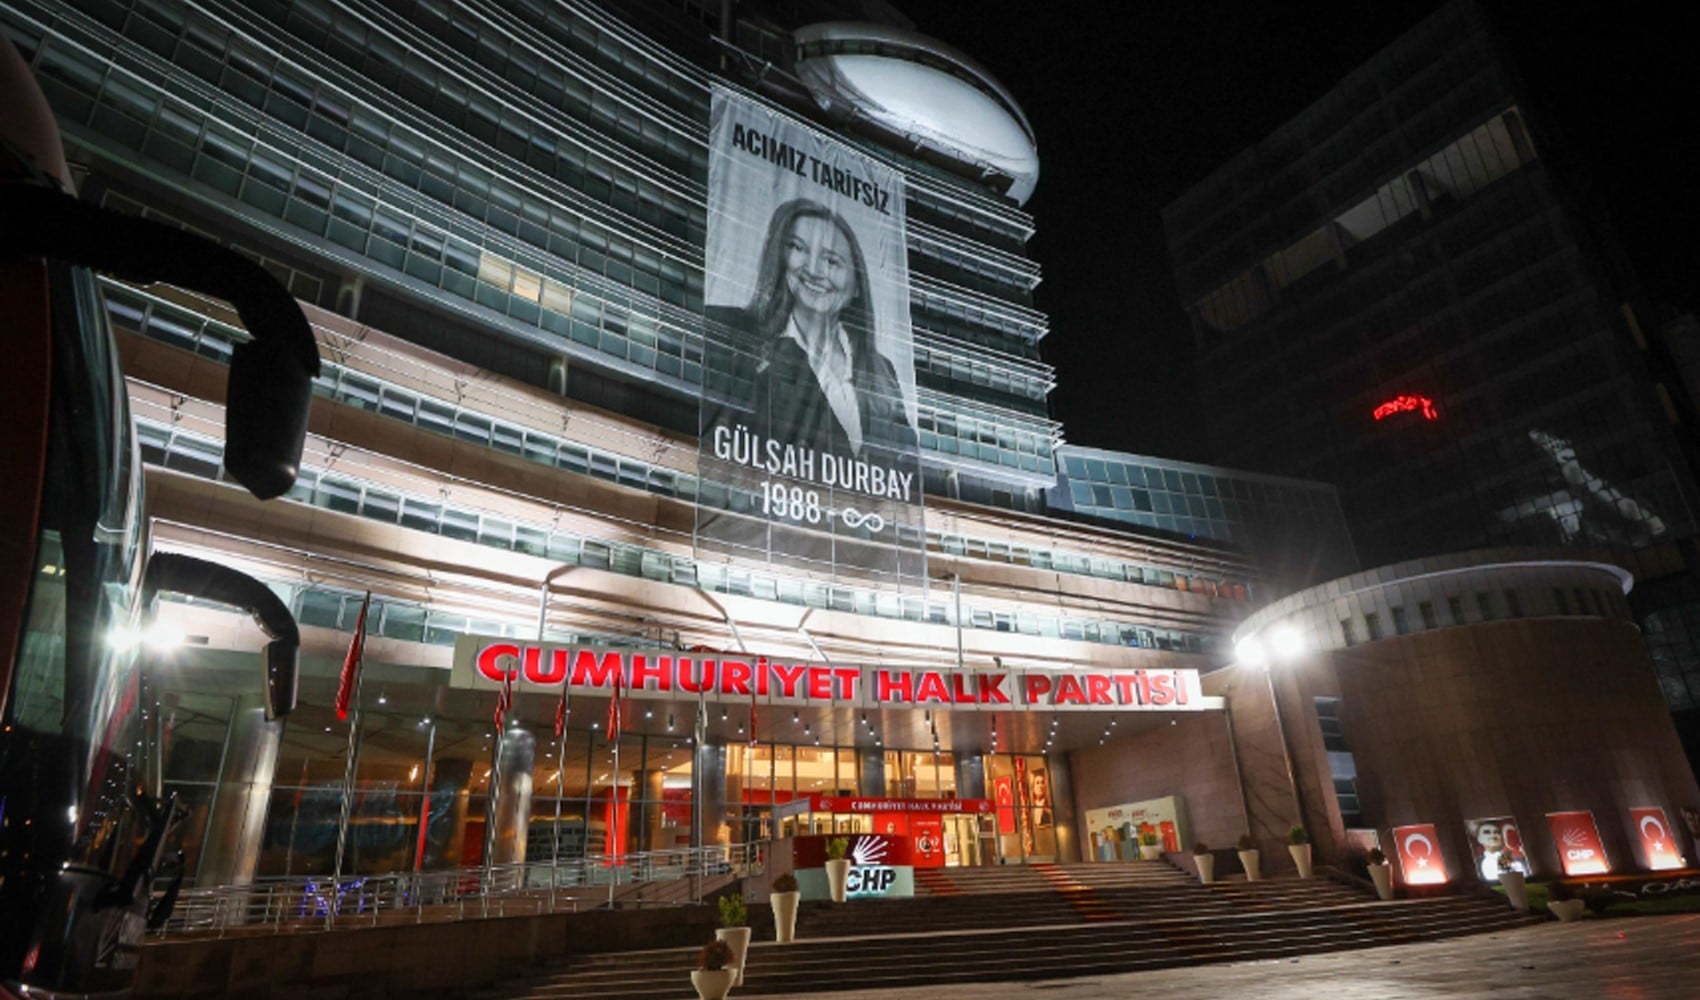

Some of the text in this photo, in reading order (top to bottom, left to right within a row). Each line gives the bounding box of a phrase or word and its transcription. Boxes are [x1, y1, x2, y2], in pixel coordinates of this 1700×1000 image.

[732, 123, 890, 217] ACIMIZ TARİFSİZ
[821, 453, 913, 501] DURBAY
[760, 481, 821, 524] 1988
[476, 643, 1189, 706] CUMHURİYET HALK PARTİSİ
[846, 868, 896, 892] CHP
